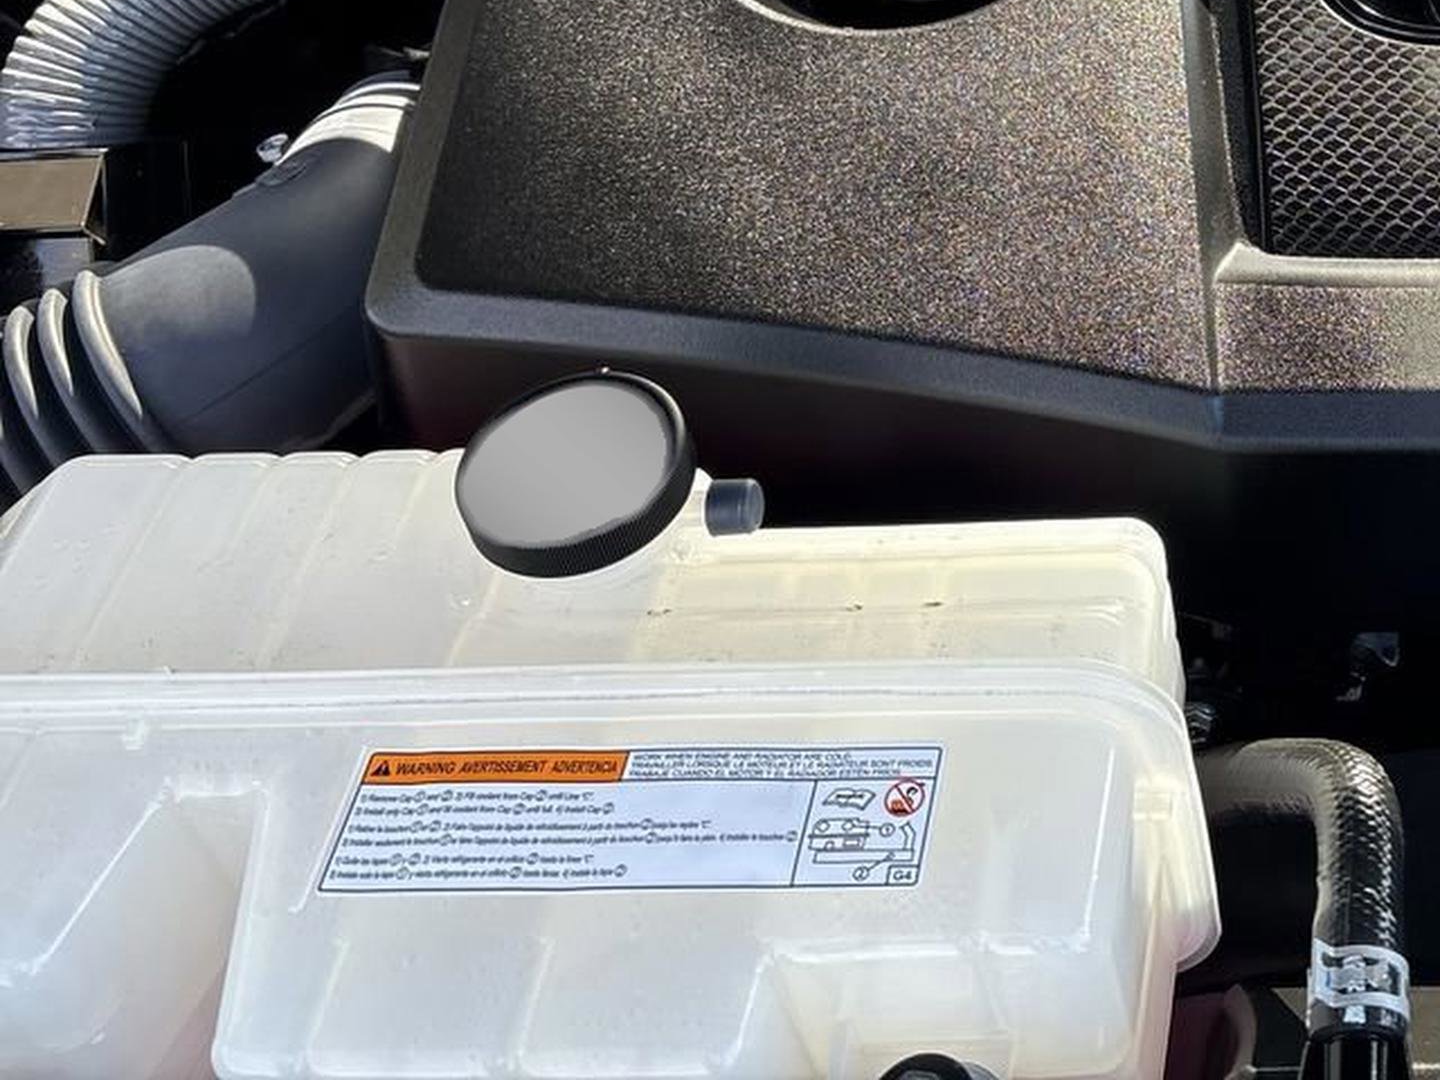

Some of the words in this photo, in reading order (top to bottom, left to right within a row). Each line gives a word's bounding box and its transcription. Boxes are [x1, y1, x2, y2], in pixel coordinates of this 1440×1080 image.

[396, 761, 455, 775] WARNING
[459, 760, 547, 774] AVERTISSEMENT
[552, 759, 618, 773] ADVERTENCIA
